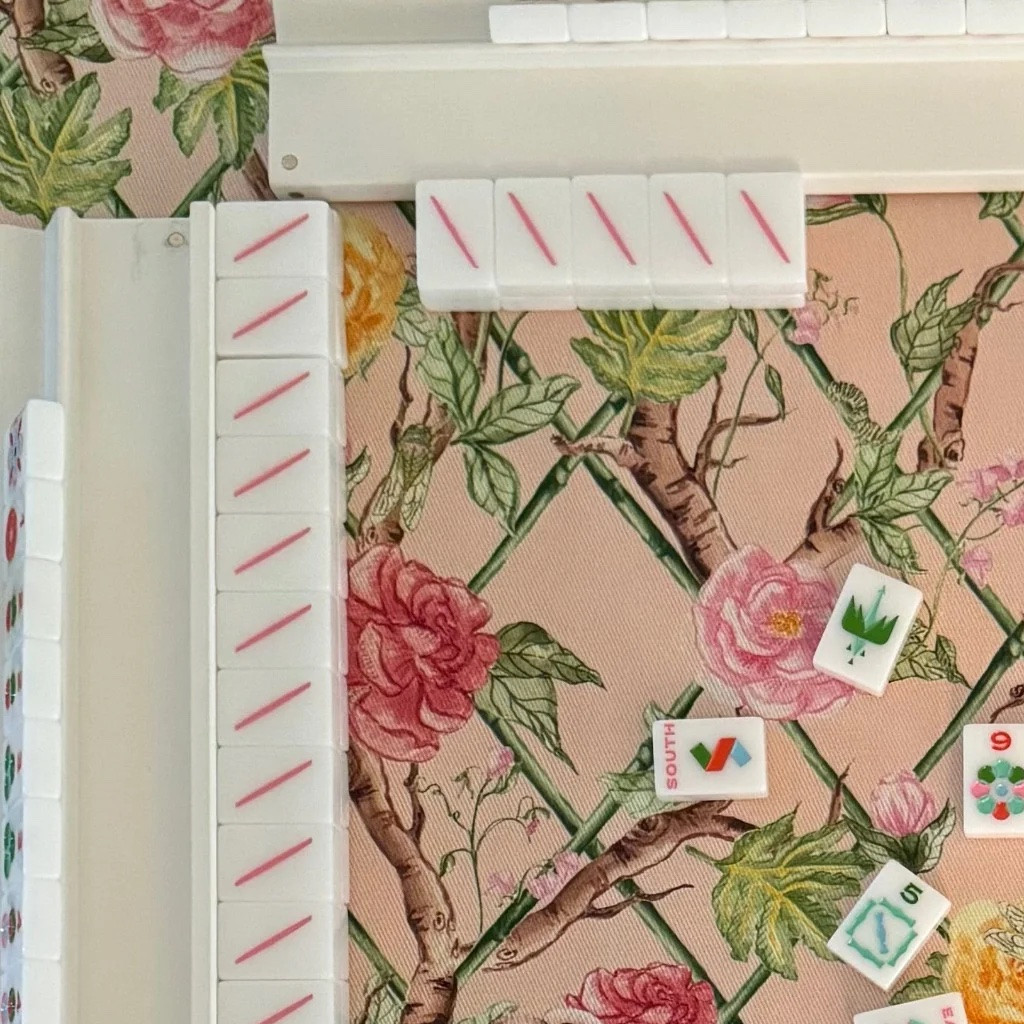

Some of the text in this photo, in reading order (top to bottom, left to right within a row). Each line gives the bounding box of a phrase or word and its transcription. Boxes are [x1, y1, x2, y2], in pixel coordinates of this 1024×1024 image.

[990, 730, 1013, 752] 9
[664, 723, 678, 790] SOUTH
[901, 882, 924, 905] 5
